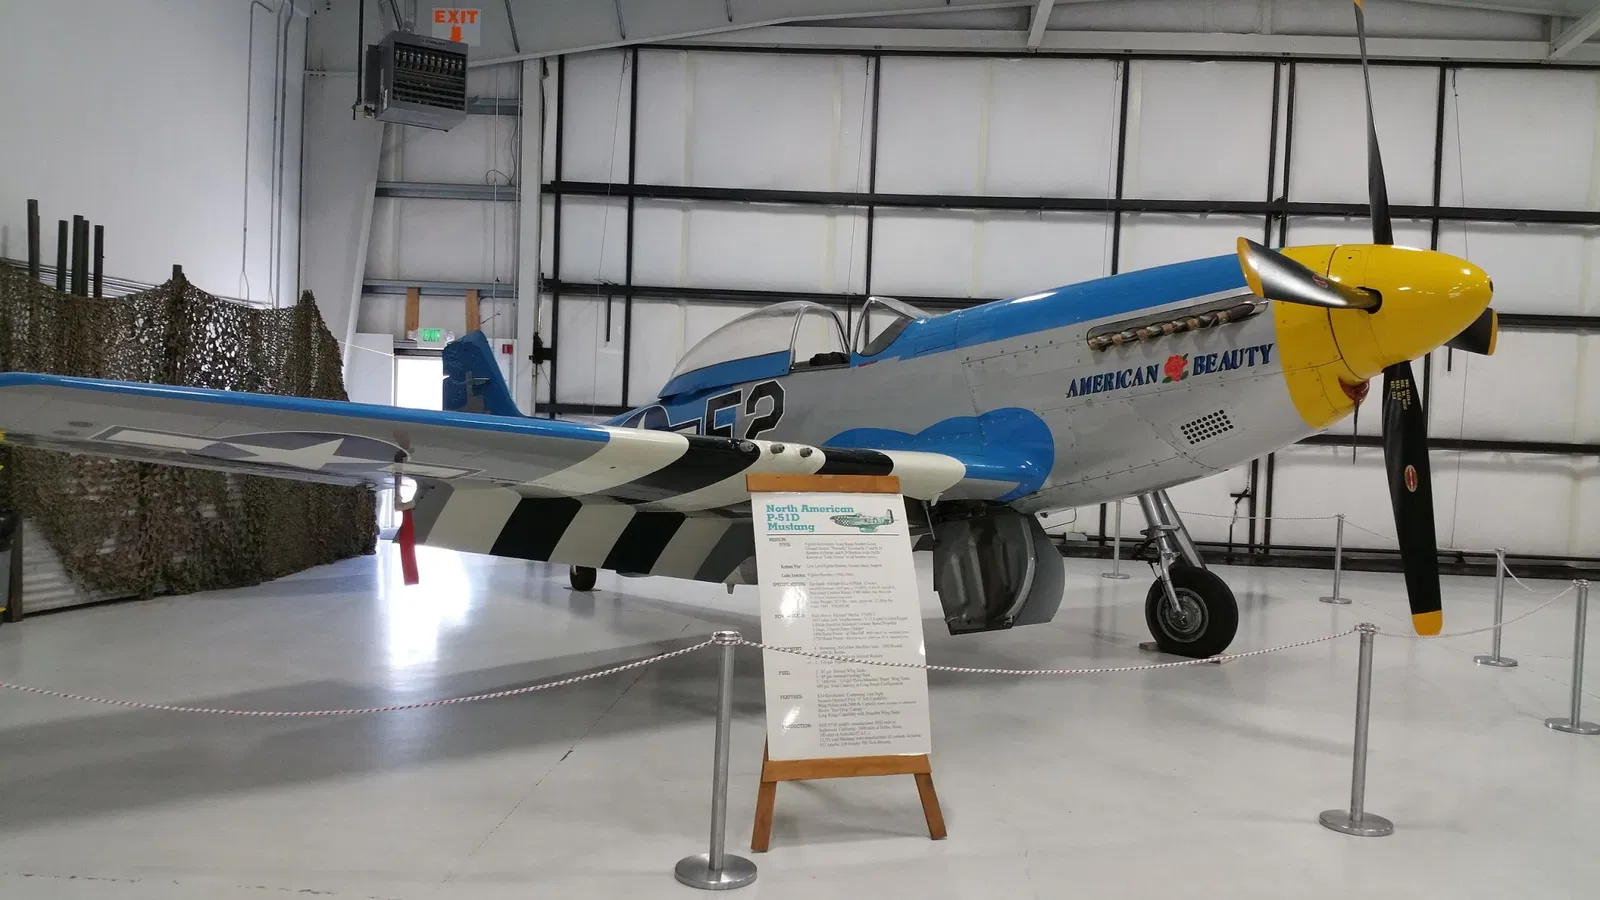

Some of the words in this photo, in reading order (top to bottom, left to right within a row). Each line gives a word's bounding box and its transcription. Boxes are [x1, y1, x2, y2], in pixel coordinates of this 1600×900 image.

[434, 10, 479, 24] EXIT
[422, 328, 441, 342] EXIT
[1066, 364, 1160, 398] AMERICAN
[1192, 343, 1274, 376] BEAUTY
[766, 504, 798, 513] North
[801, 504, 854, 513] American
[767, 513, 800, 522] P-51D
[768, 522, 815, 532] Mustang
